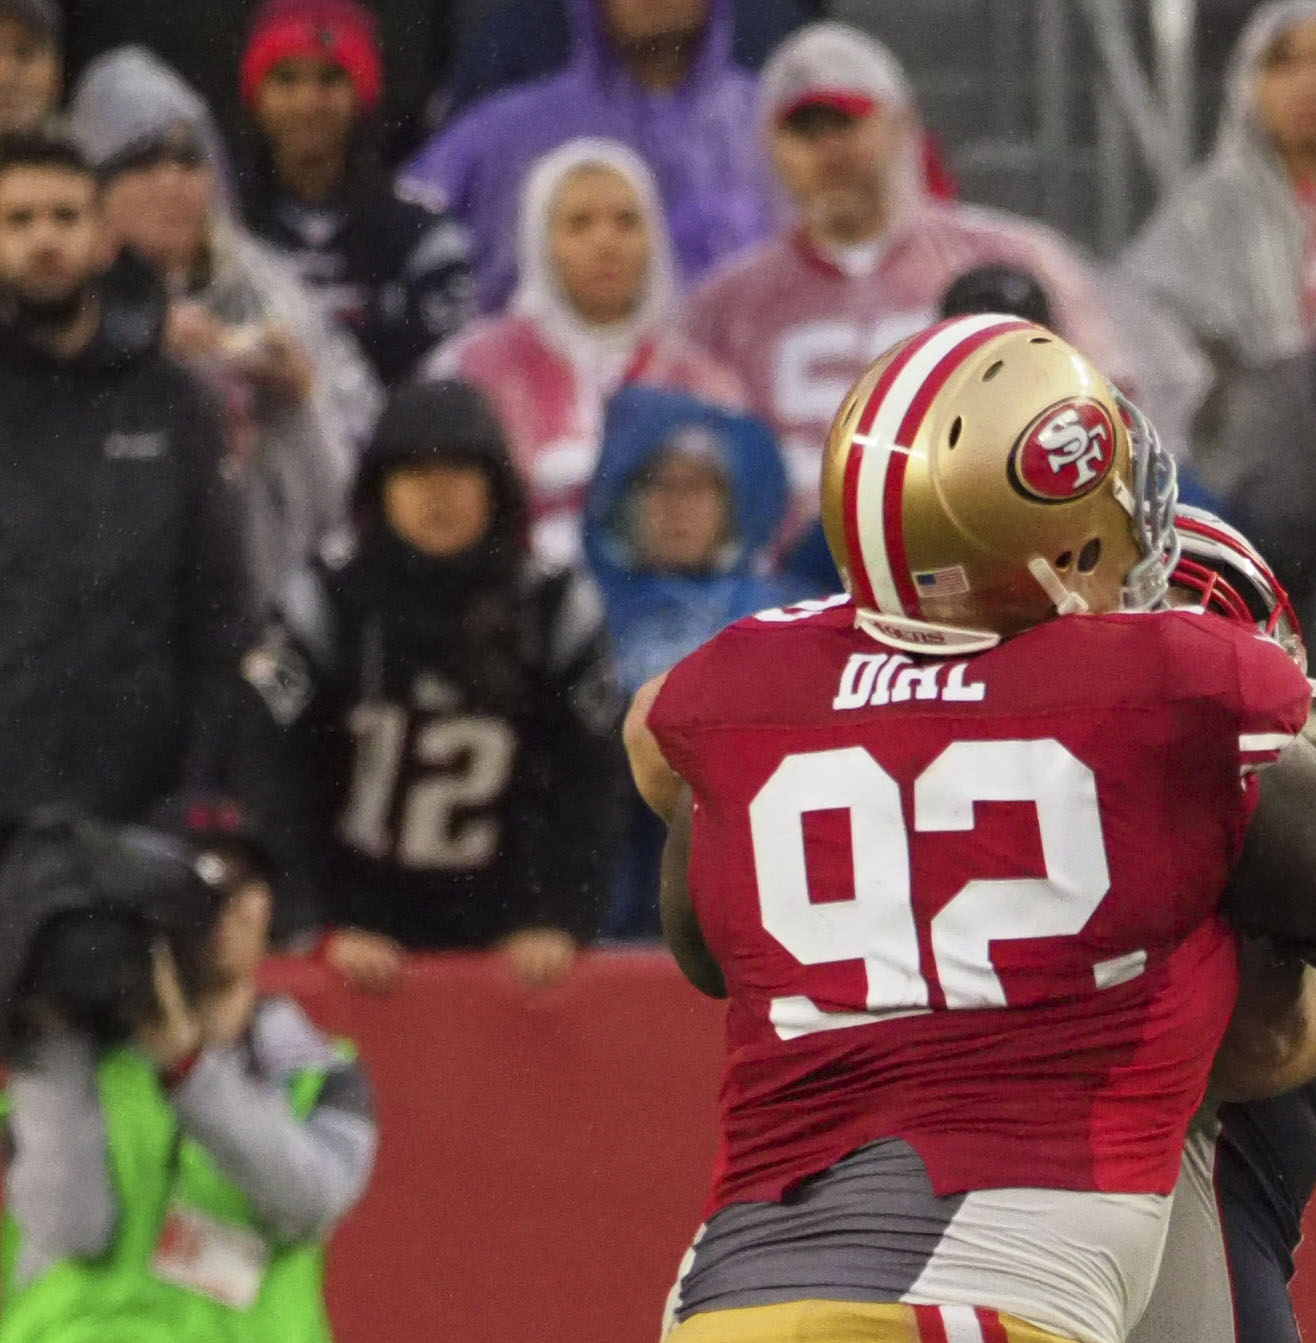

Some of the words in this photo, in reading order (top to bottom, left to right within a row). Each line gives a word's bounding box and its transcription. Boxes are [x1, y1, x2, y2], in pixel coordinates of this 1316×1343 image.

[832, 652, 987, 711] DIAL
[338, 702, 518, 870] 12
[749, 738, 1148, 1041] 92
